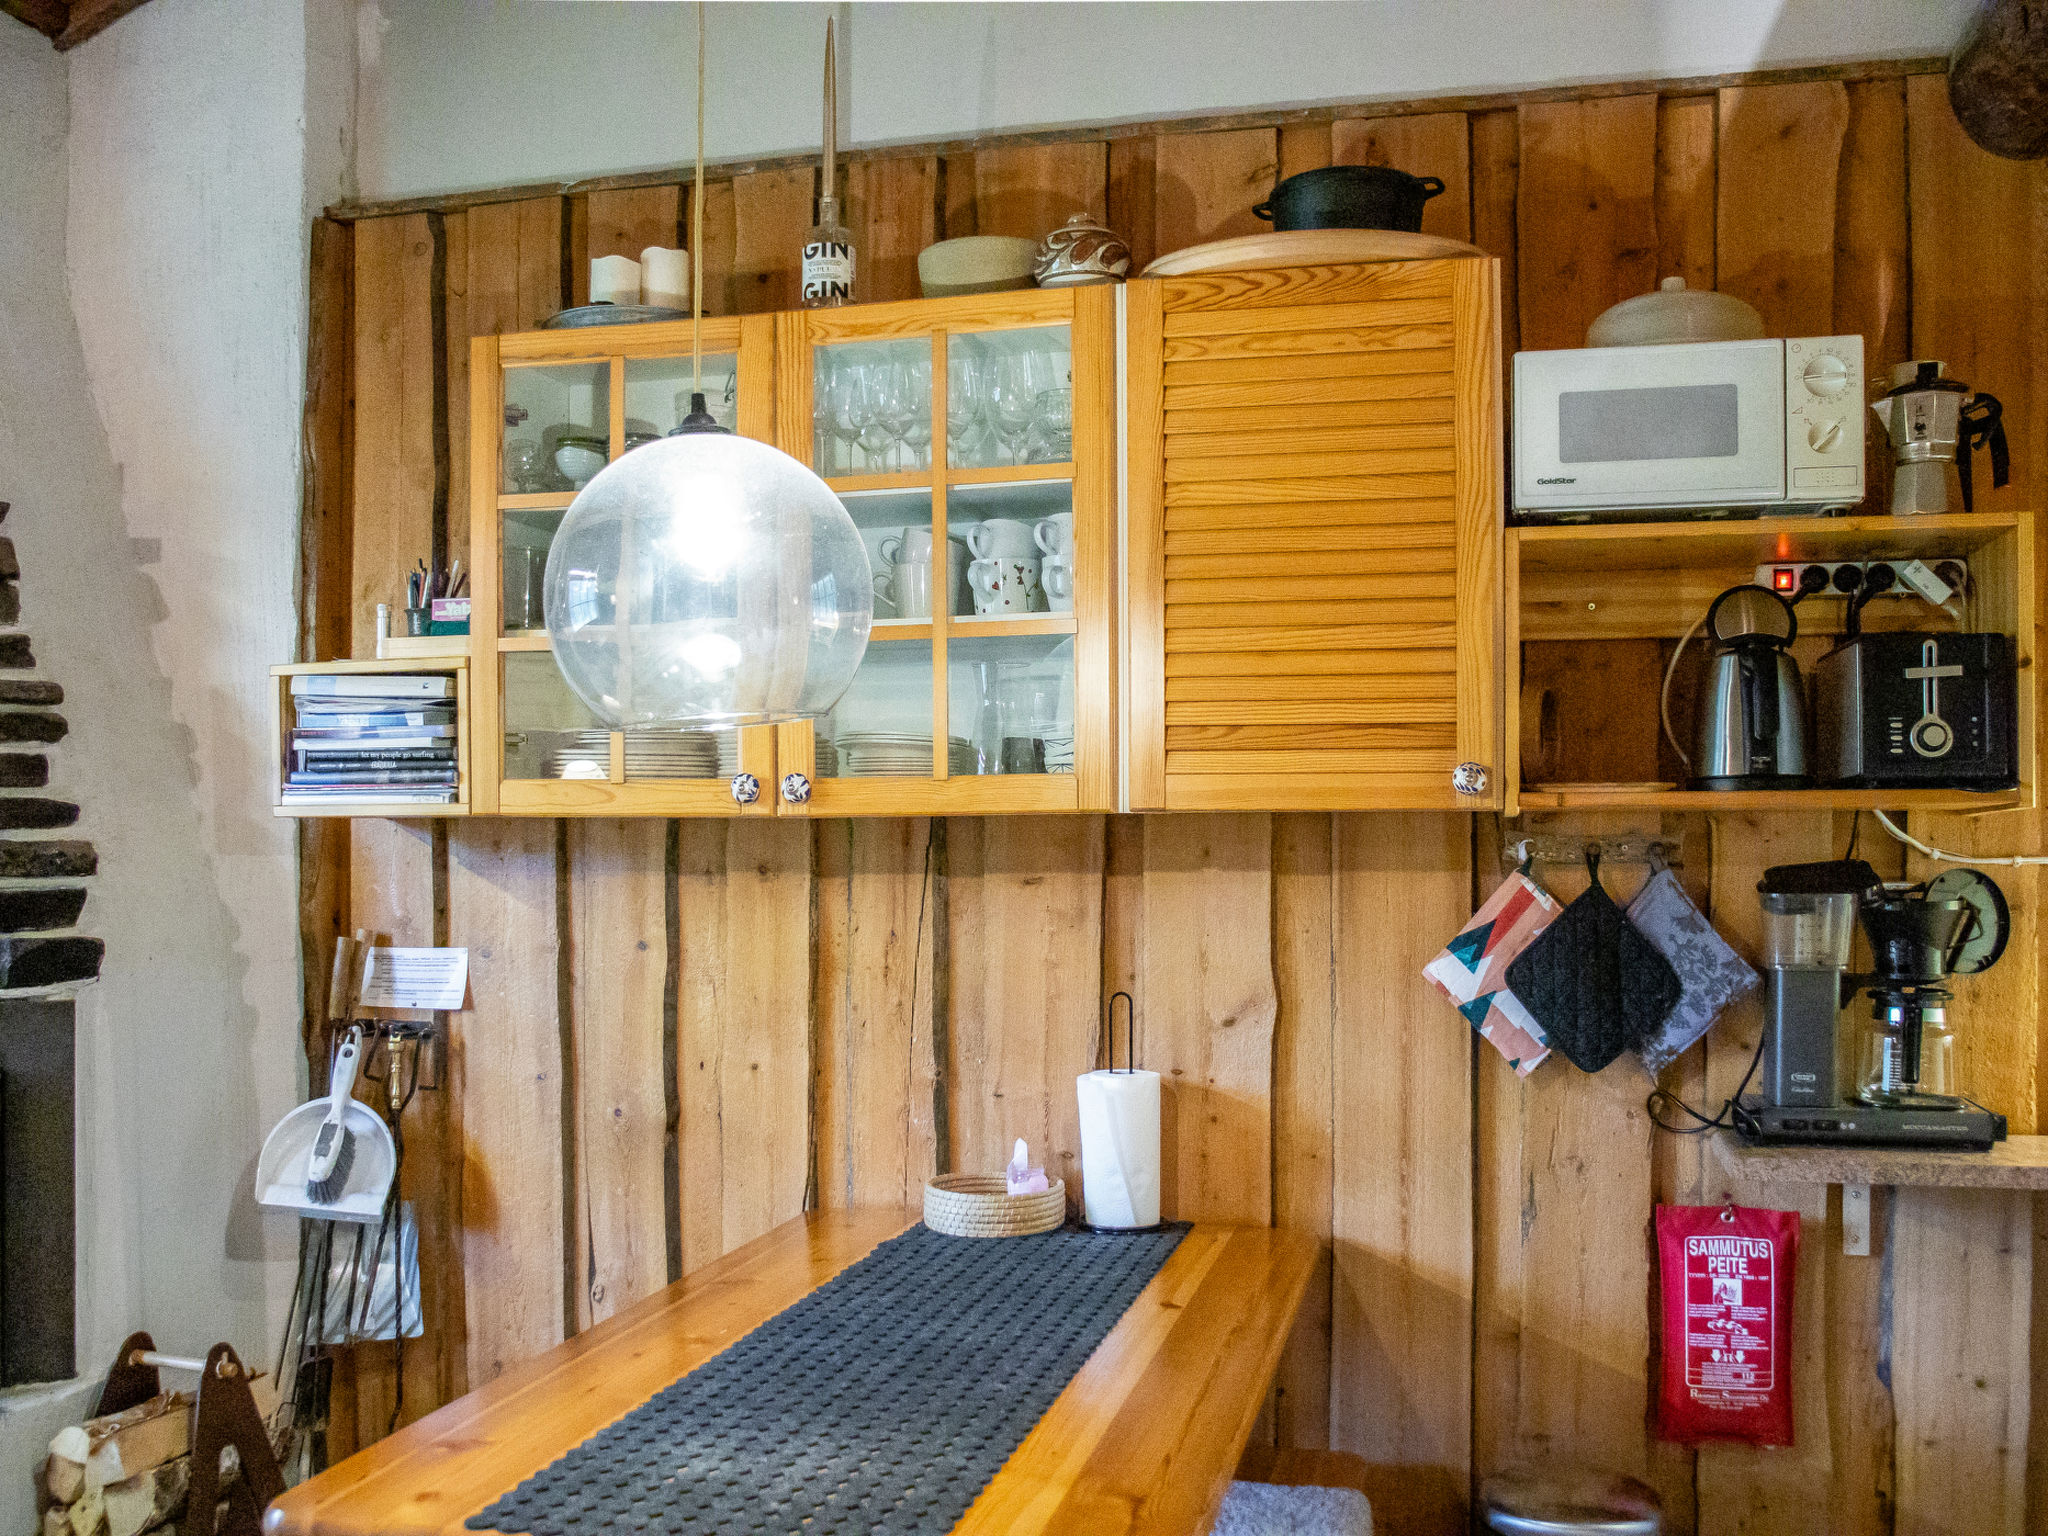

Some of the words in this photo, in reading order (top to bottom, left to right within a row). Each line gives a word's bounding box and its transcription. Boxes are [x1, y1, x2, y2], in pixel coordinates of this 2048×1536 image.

[804, 242, 848, 260] GIN
[804, 281, 848, 299] GIN
[1536, 477, 1577, 485] GoldStar
[381, 751, 401, 759] people
[412, 751, 435, 759] surfing
[1688, 1239, 1769, 1259] SAMMUTUS
[1708, 1256, 1749, 1274] PEITE
